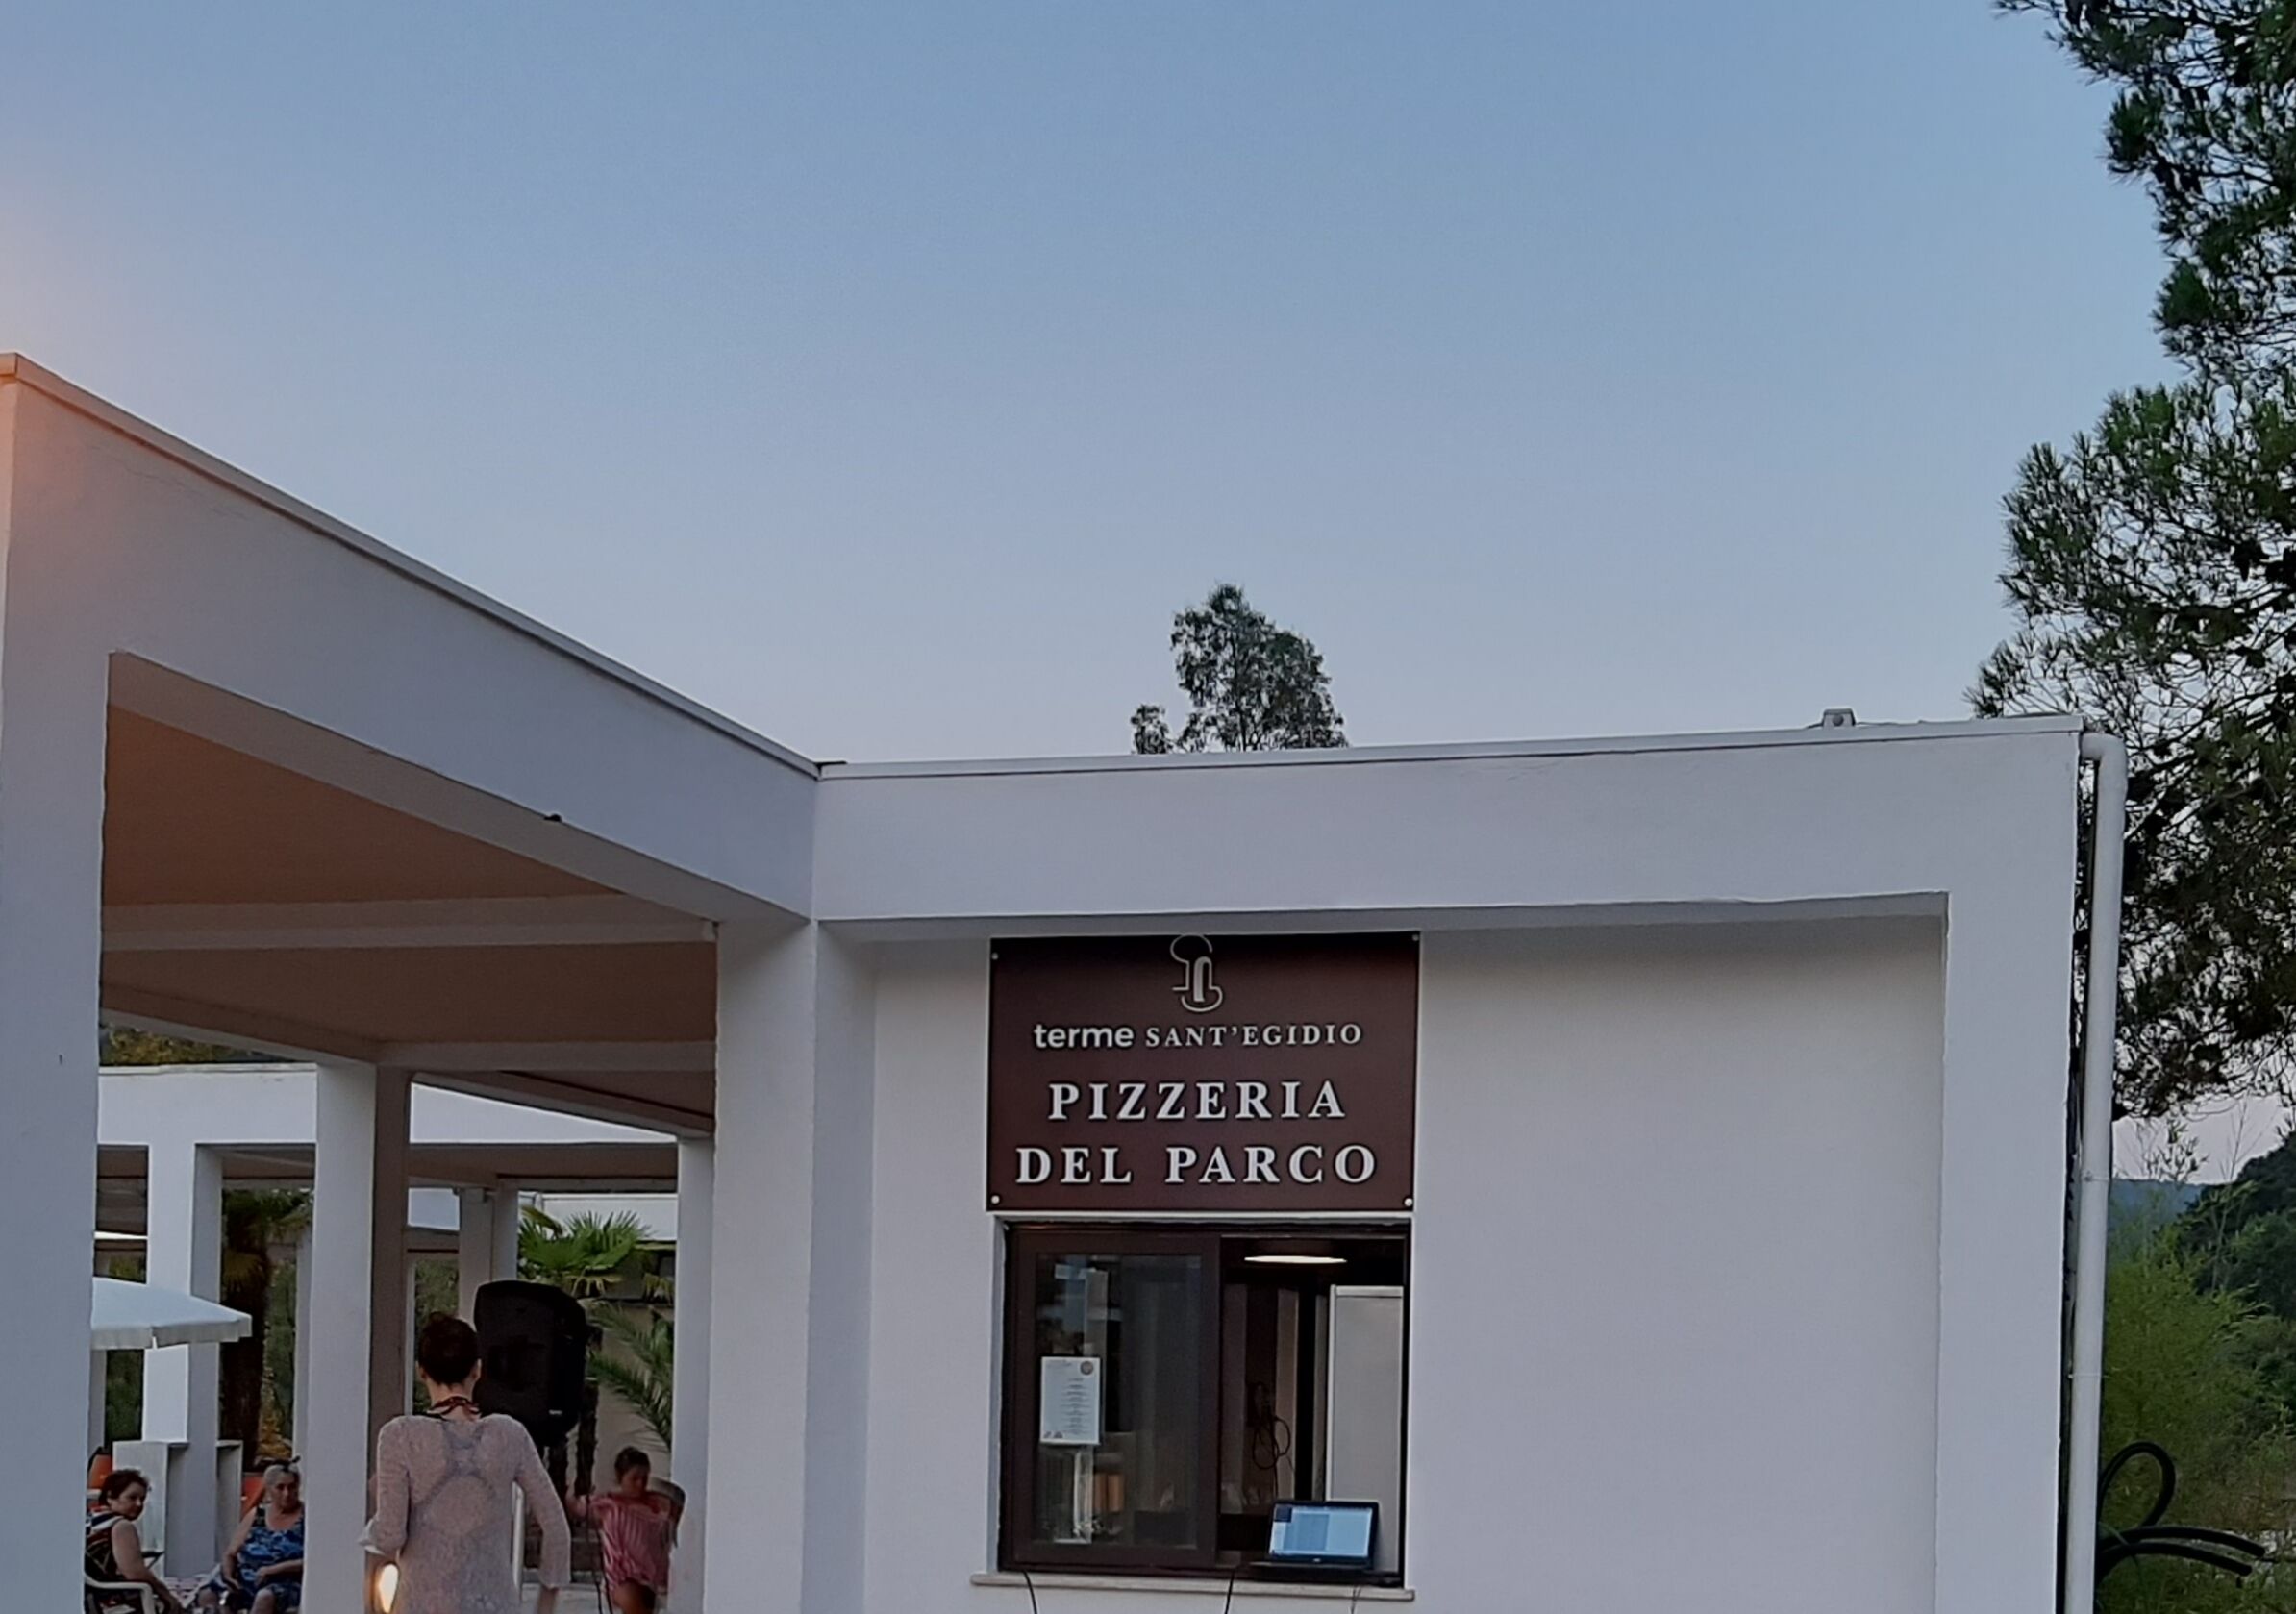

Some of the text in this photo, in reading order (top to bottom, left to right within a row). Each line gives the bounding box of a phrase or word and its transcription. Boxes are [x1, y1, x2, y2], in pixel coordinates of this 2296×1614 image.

[1034, 1023, 1361, 1049] terme SANT’EGIDIO
[1048, 1080, 1346, 1121] PIZZERIA
[1015, 1144, 1376, 1184] DEL PARCO
